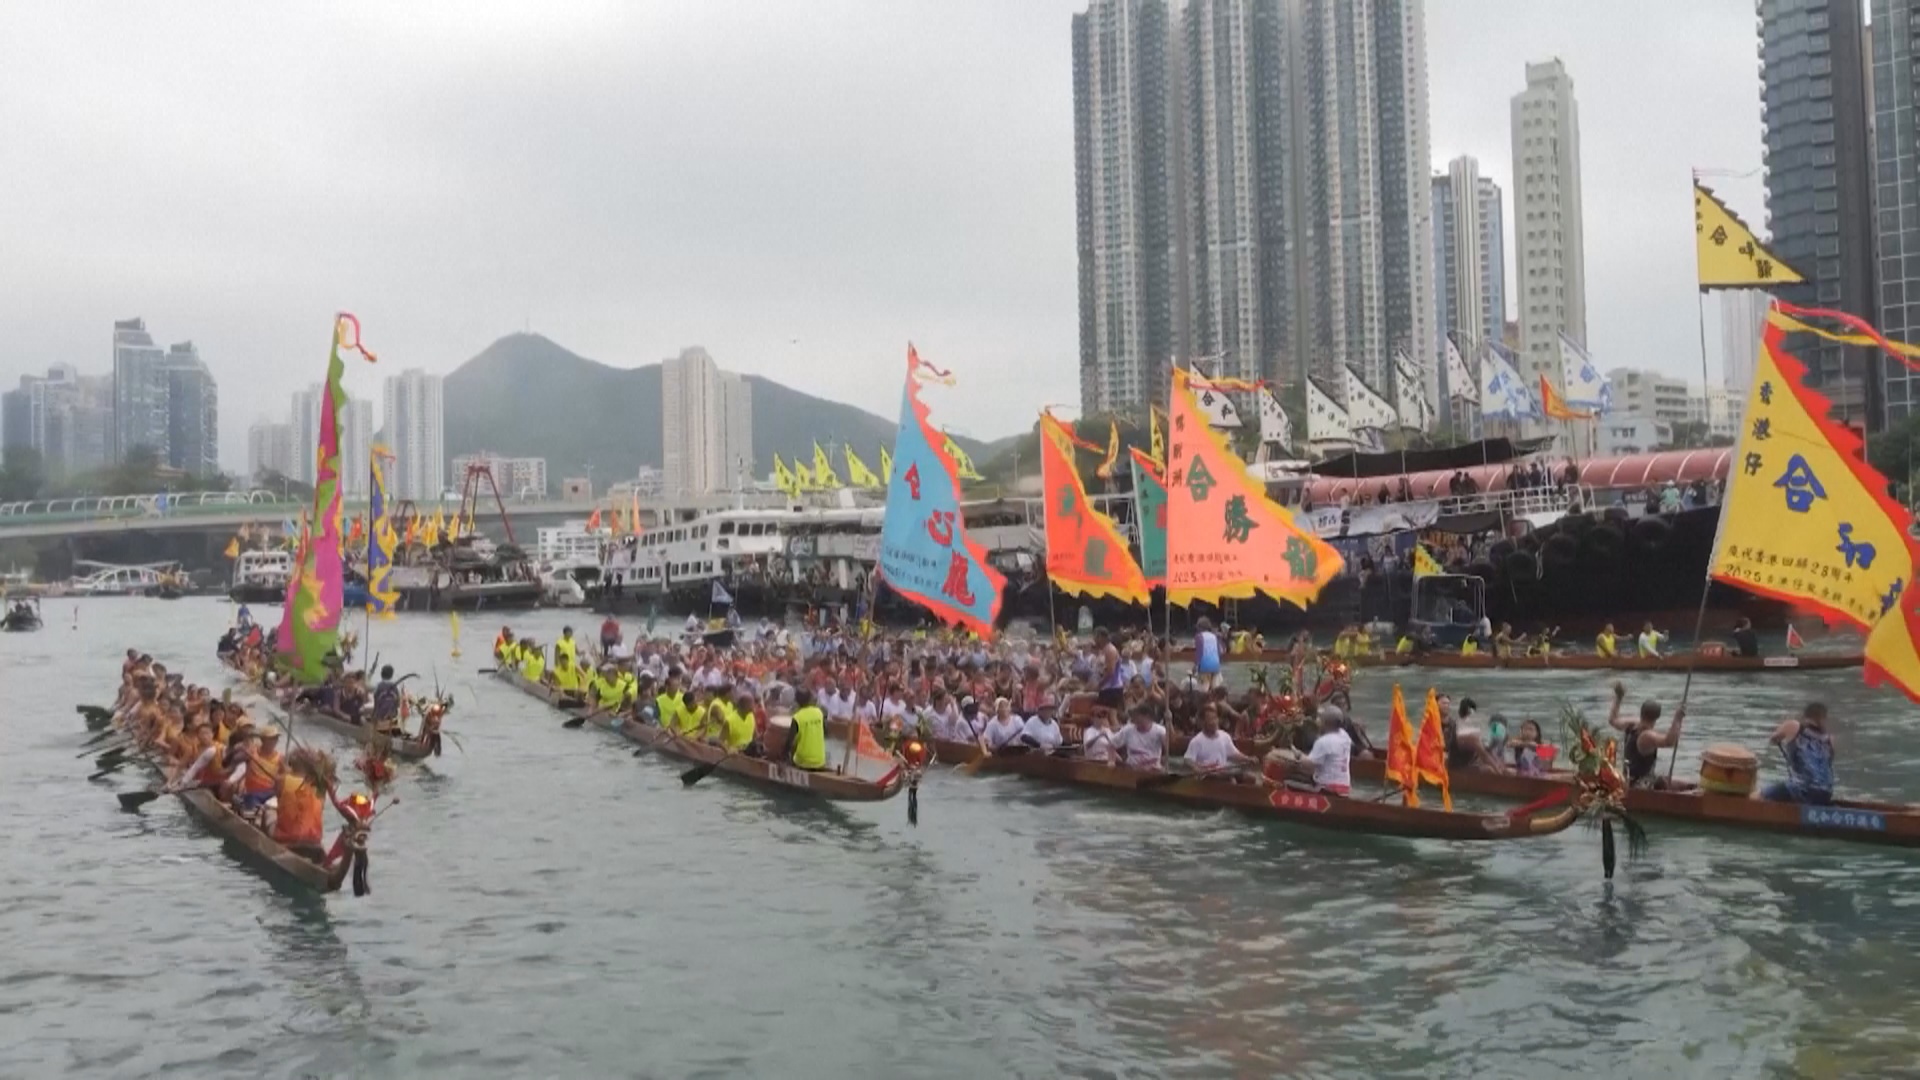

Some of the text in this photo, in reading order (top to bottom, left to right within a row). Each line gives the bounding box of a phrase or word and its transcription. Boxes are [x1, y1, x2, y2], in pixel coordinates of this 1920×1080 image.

[1745, 381, 1773, 476] 香港仔
[1186, 454, 1318, 584] 合勝龍
